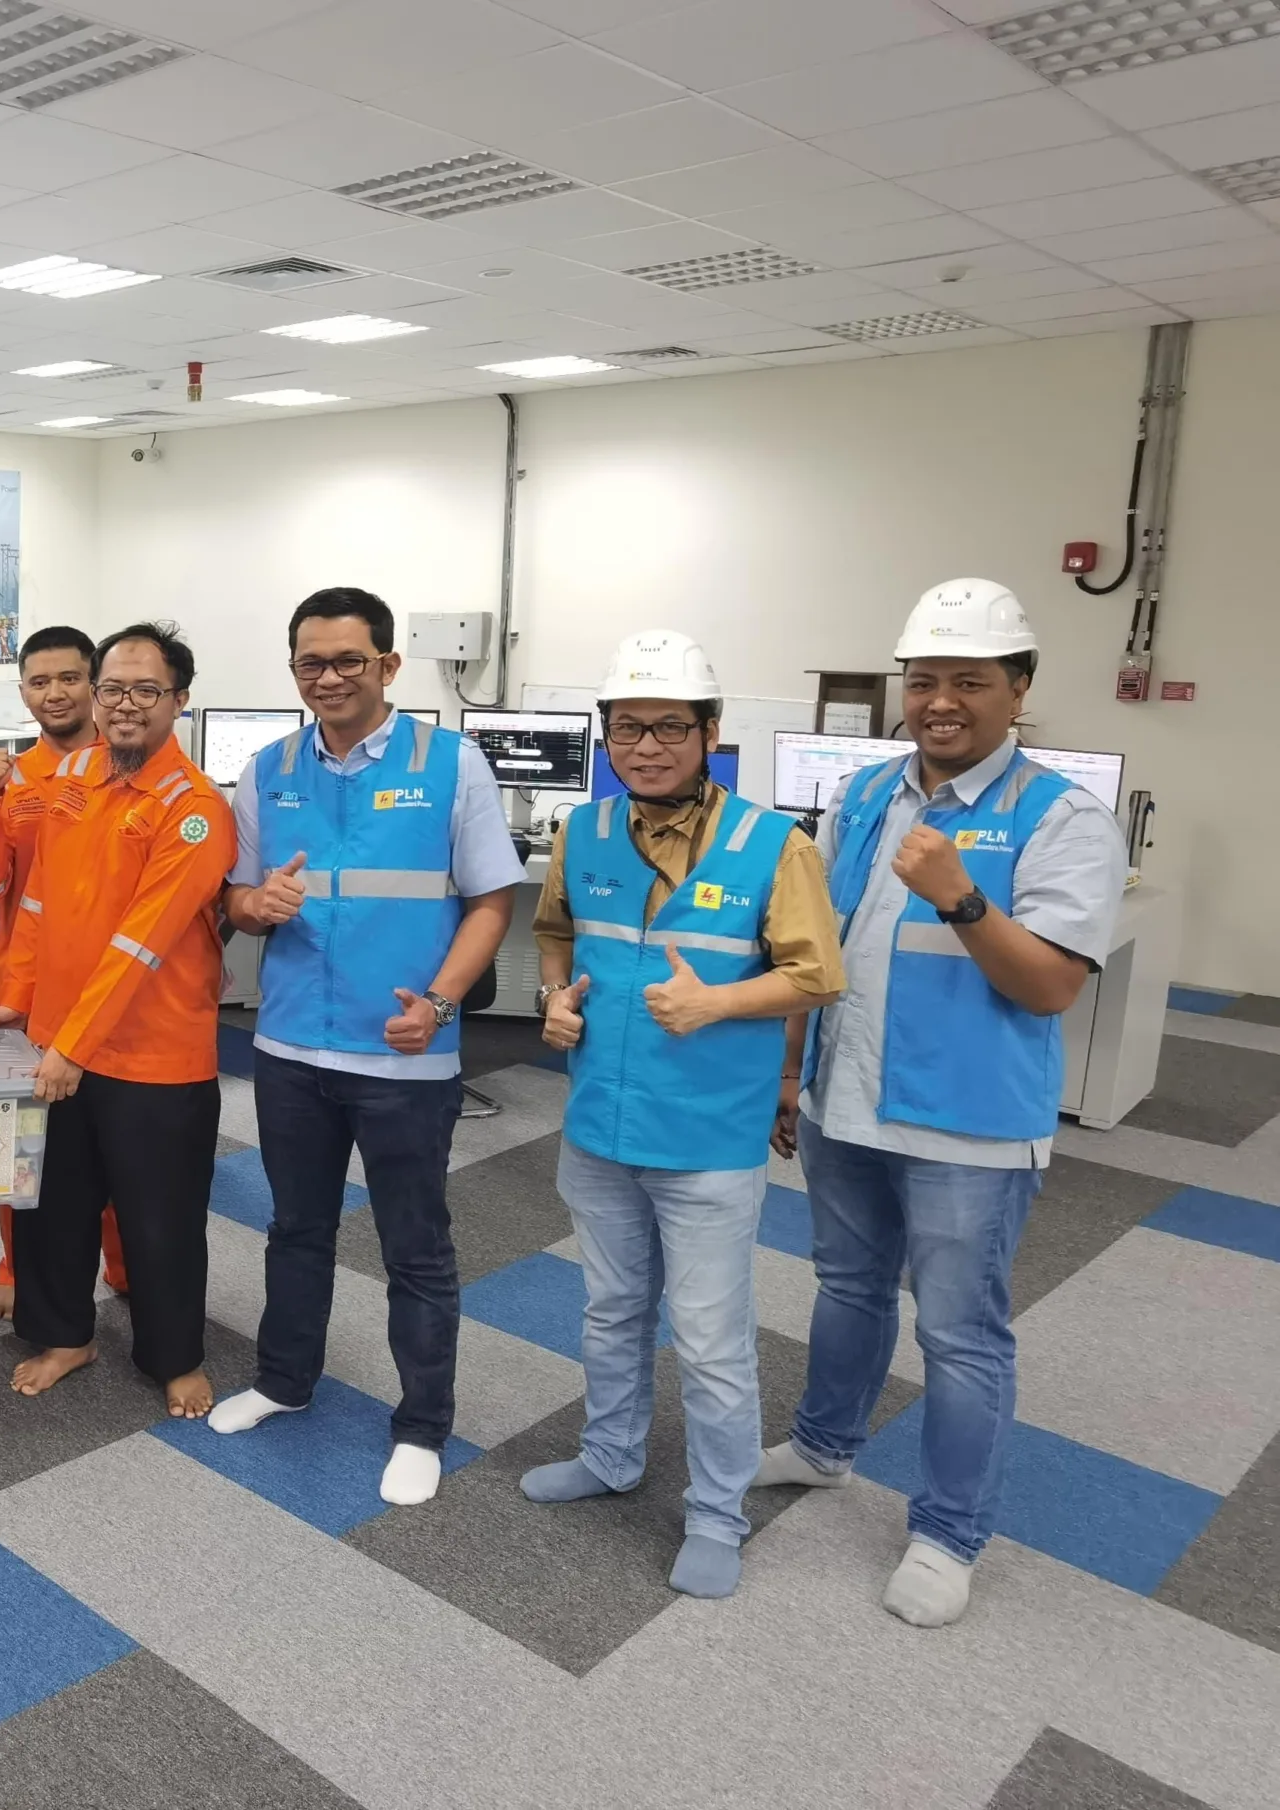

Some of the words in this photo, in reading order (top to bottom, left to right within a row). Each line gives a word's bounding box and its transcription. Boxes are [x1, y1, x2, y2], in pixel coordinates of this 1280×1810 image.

[394, 787, 424, 800] PLN
[976, 829, 1009, 844] PLN
[588, 885, 613, 897] VVIP
[723, 893, 750, 907] PLN
